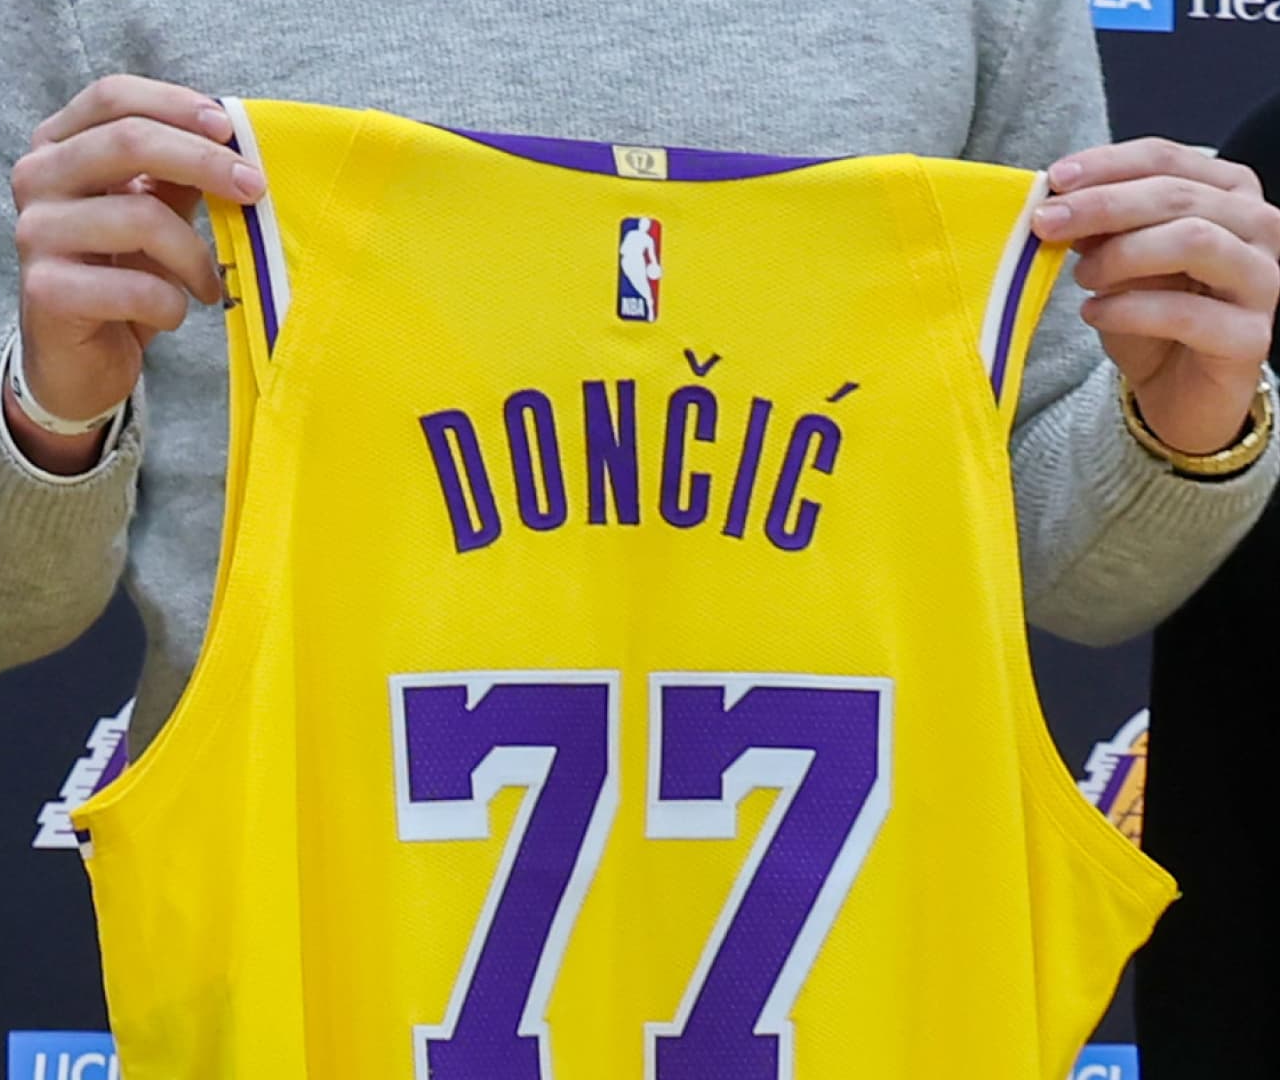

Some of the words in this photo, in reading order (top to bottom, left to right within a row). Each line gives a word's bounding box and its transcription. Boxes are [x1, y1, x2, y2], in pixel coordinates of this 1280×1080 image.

[418, 347, 862, 555] DONČIĆ
[386, 668, 895, 1080] 77
[34, 1052, 120, 1080] UC
